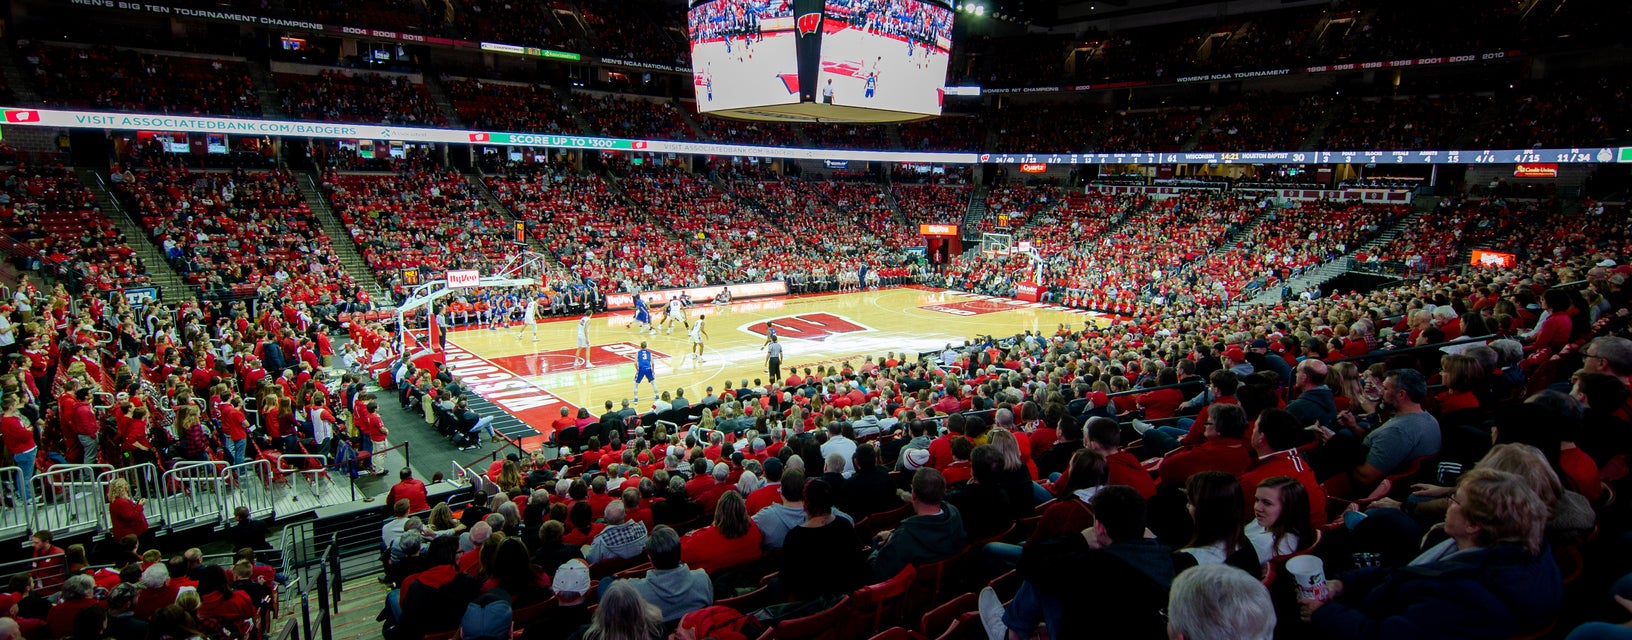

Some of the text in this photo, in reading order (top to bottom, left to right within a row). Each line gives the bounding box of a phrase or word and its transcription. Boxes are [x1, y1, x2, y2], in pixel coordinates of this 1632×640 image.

[118, 1, 141, 10] BIG
[144, 4, 170, 14] TEN
[174, 7, 257, 23] TOURNAMENT
[260, 17, 323, 30] CHAMPIONS
[342, 26, 367, 35] 2004
[402, 33, 424, 42] 2015
[601, 57, 622, 65] MEN'S
[623, 59, 642, 68] NCAA
[643, 61, 673, 71] NATIONAL
[1176, 74, 1209, 83] WOMEN'S
[1234, 69, 1290, 79] TOURNAMENT
[1418, 57, 1442, 65] 2001
[1449, 54, 1475, 63] 2002
[1482, 51, 1505, 60] 2010
[76, 114, 356, 135] VISIT ASSOCIATEDBANK.COM/BADGERS
[510, 134, 549, 145] SCORE
[552, 136, 568, 146] UP
[570, 136, 585, 146] TO
[663, 143, 683, 151] VISIT
[1167, 154, 1177, 162] 61
[1292, 154, 1305, 162] 30
